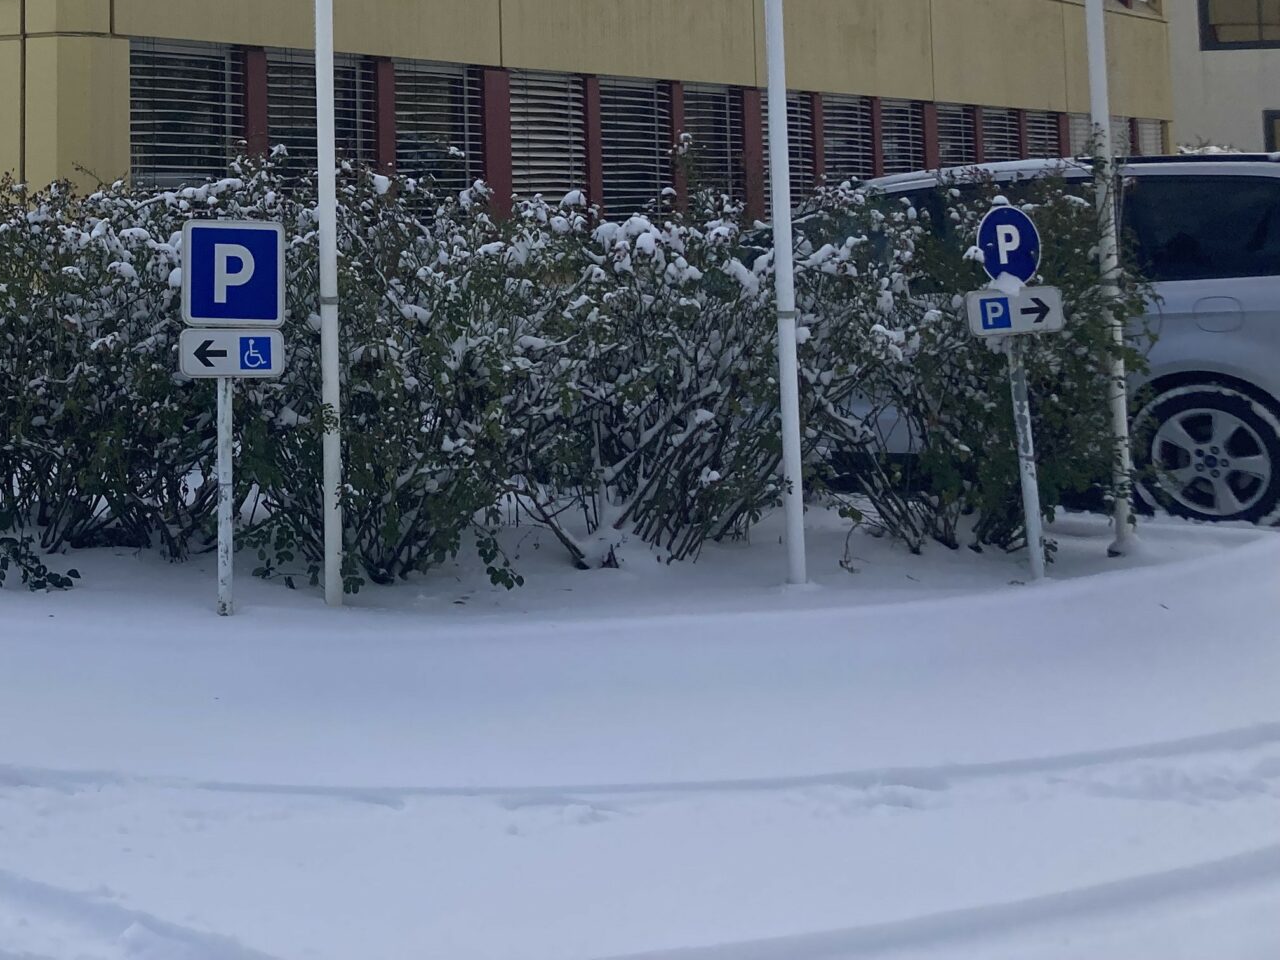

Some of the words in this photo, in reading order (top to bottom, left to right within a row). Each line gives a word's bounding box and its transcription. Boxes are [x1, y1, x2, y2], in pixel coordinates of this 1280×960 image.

[996, 224, 1020, 265] P
[214, 243, 255, 303] P
[985, 301, 1004, 325] P
